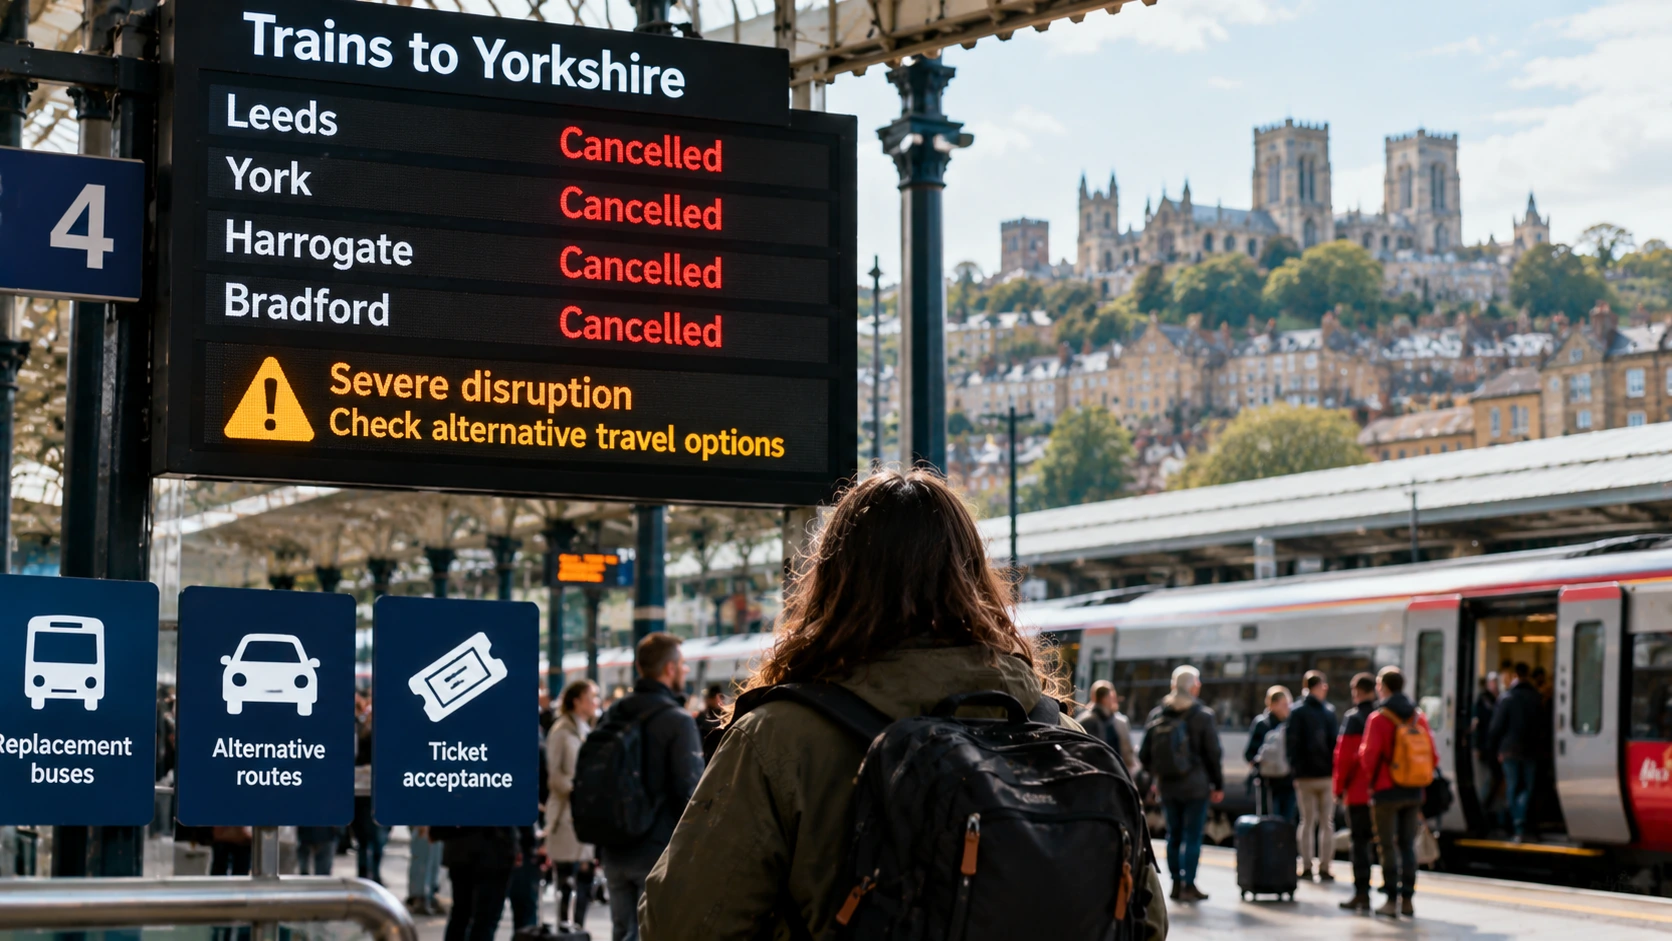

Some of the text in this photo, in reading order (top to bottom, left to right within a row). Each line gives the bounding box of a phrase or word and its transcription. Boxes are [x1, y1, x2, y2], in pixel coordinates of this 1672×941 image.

[244, 12, 684, 98] Trains to Yorkshire
[228, 94, 337, 136] Leeds
[560, 126, 722, 172] Cancelled
[226, 156, 312, 195] York
[50, 184, 113, 269] 4
[560, 186, 722, 230] Cancelled
[226, 219, 412, 270] Harrogate
[560, 246, 722, 288] Cancelled
[226, 283, 388, 326] Bradford
[560, 306, 722, 347] Cancelled
[330, 362, 631, 410] Severe disruption
[330, 408, 784, 461] Check alternative travel options
[213, 738, 325, 758] Alternative
[429, 742, 487, 761] Ticket
[32, 763, 94, 783] buses
[238, 768, 302, 785] routes
[404, 770, 512, 792] acceptance
